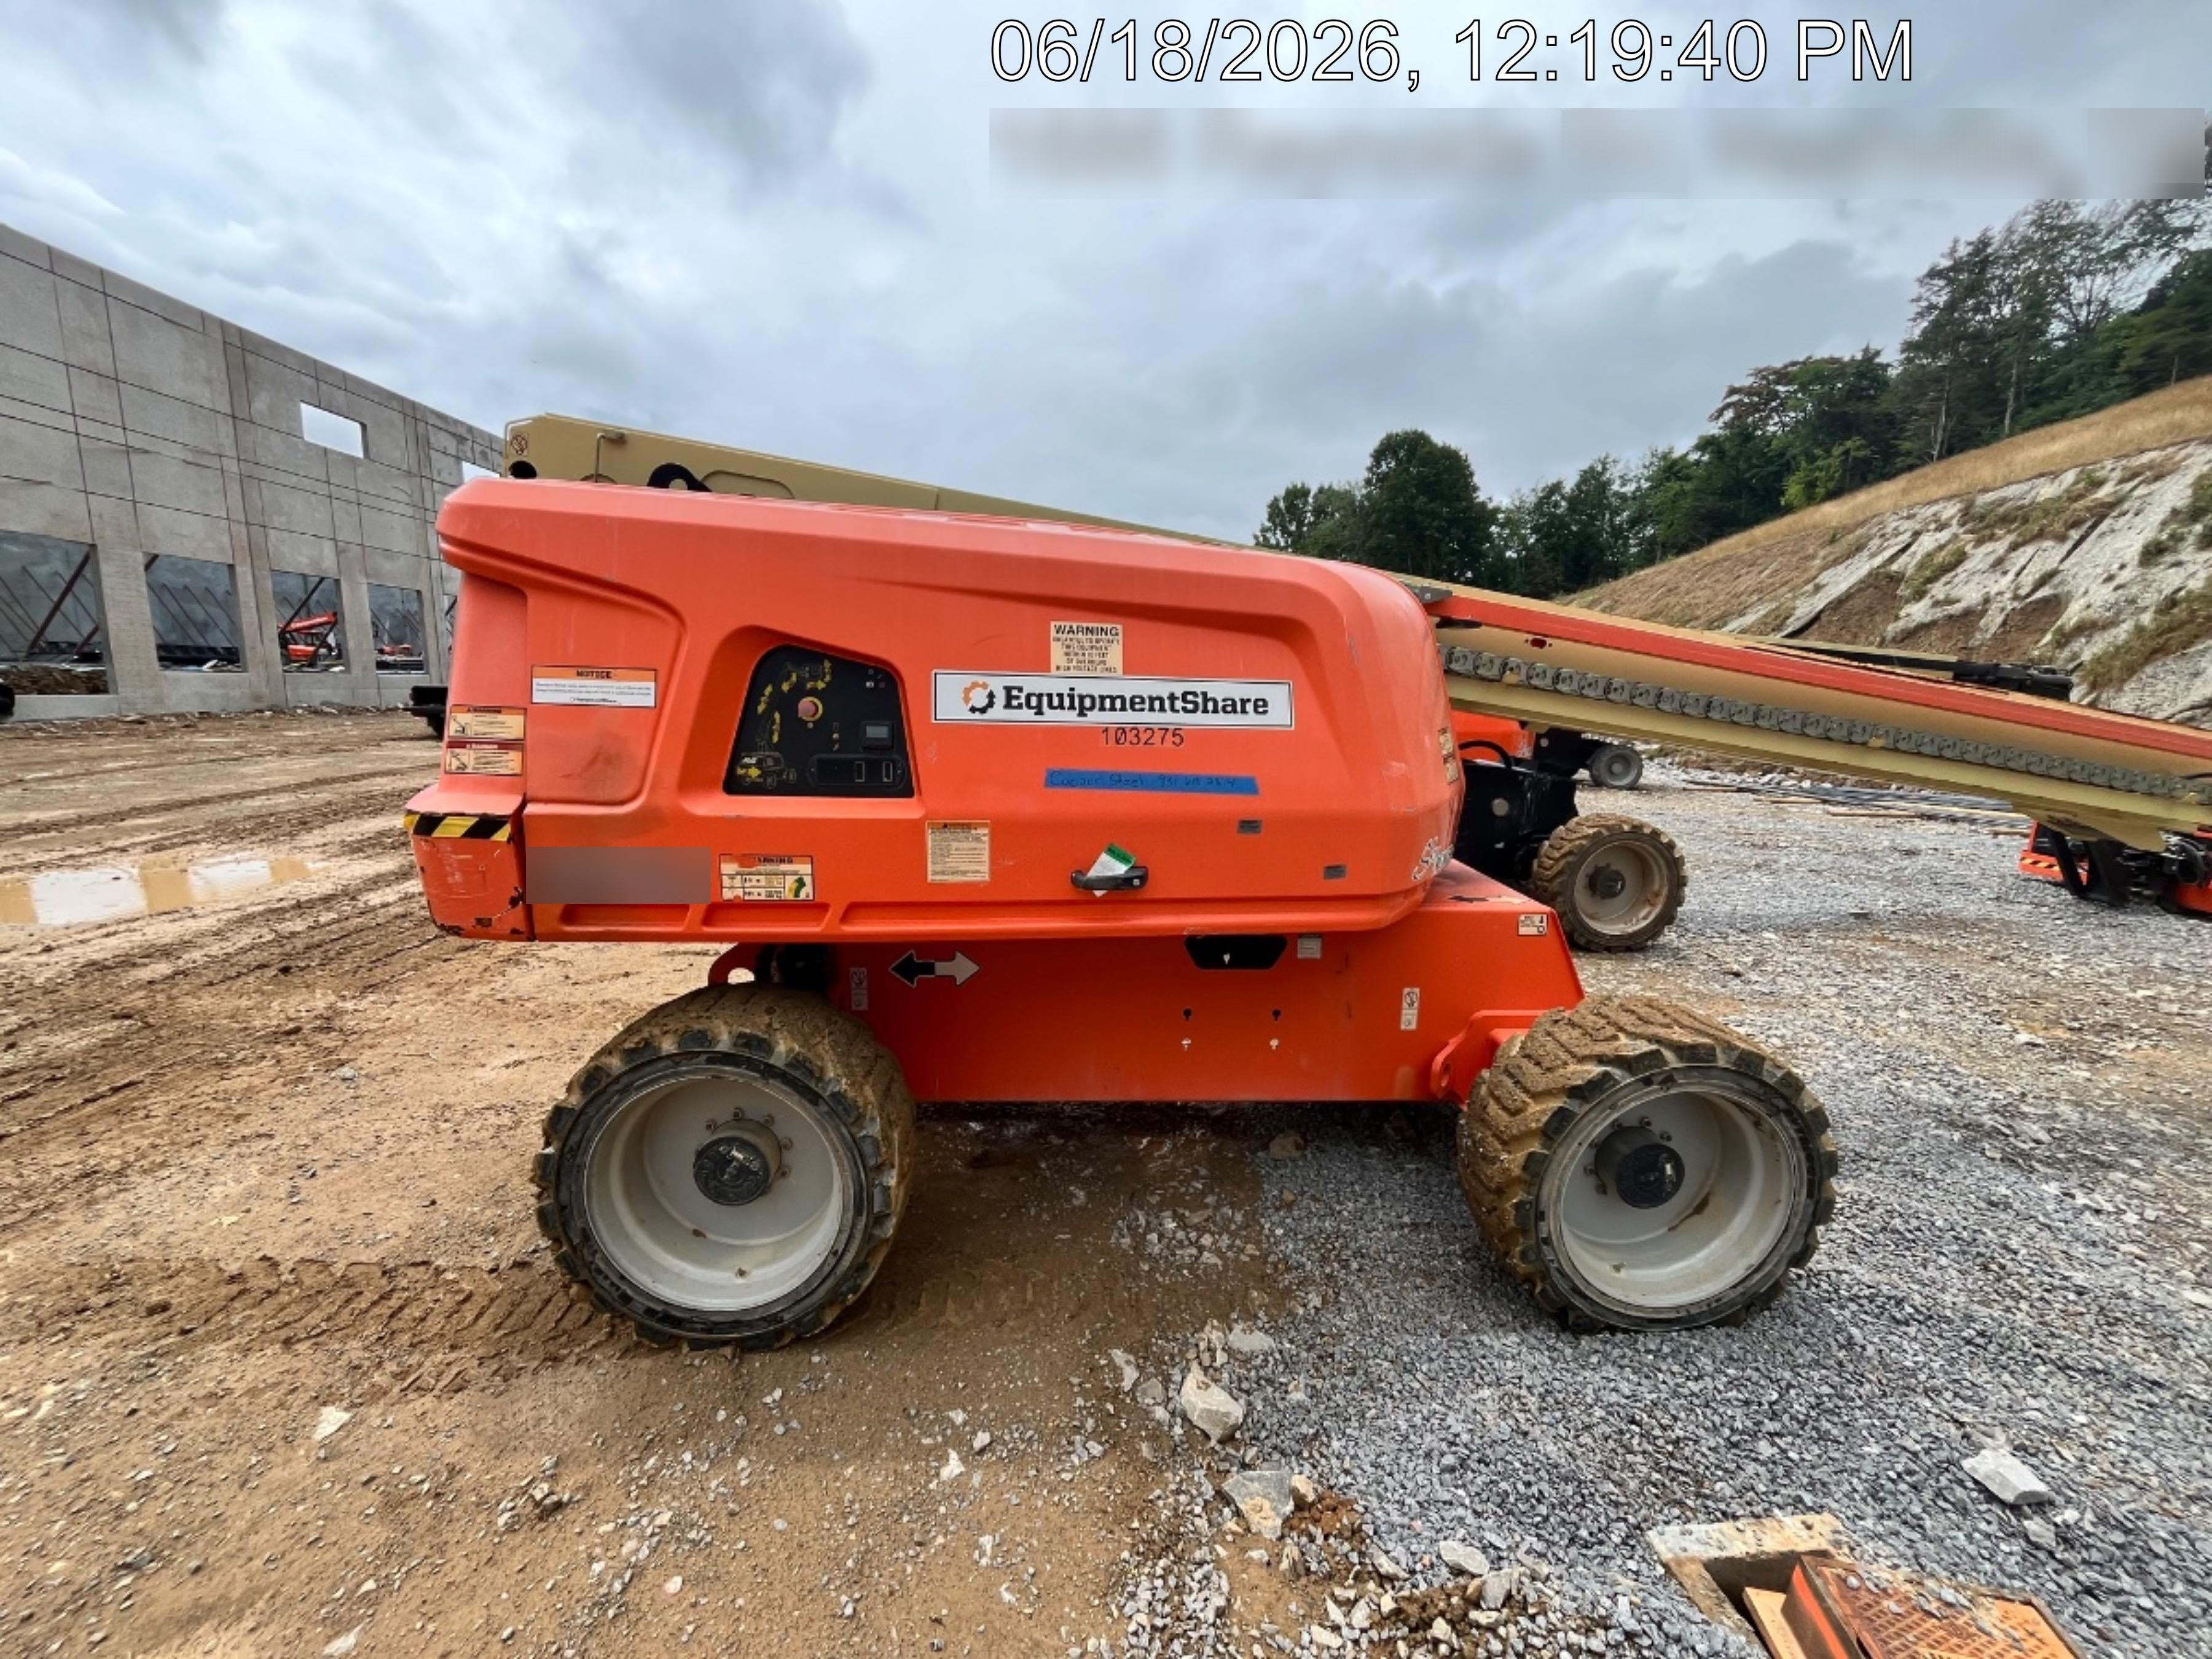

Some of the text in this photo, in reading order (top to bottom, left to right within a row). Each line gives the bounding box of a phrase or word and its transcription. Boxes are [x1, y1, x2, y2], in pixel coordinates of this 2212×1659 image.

[1054, 624, 1120, 637] WARNING
[576, 669, 612, 679] NOTICE
[1002, 685, 1269, 717] EquipmentShare
[1102, 727, 1185, 747] 103275
